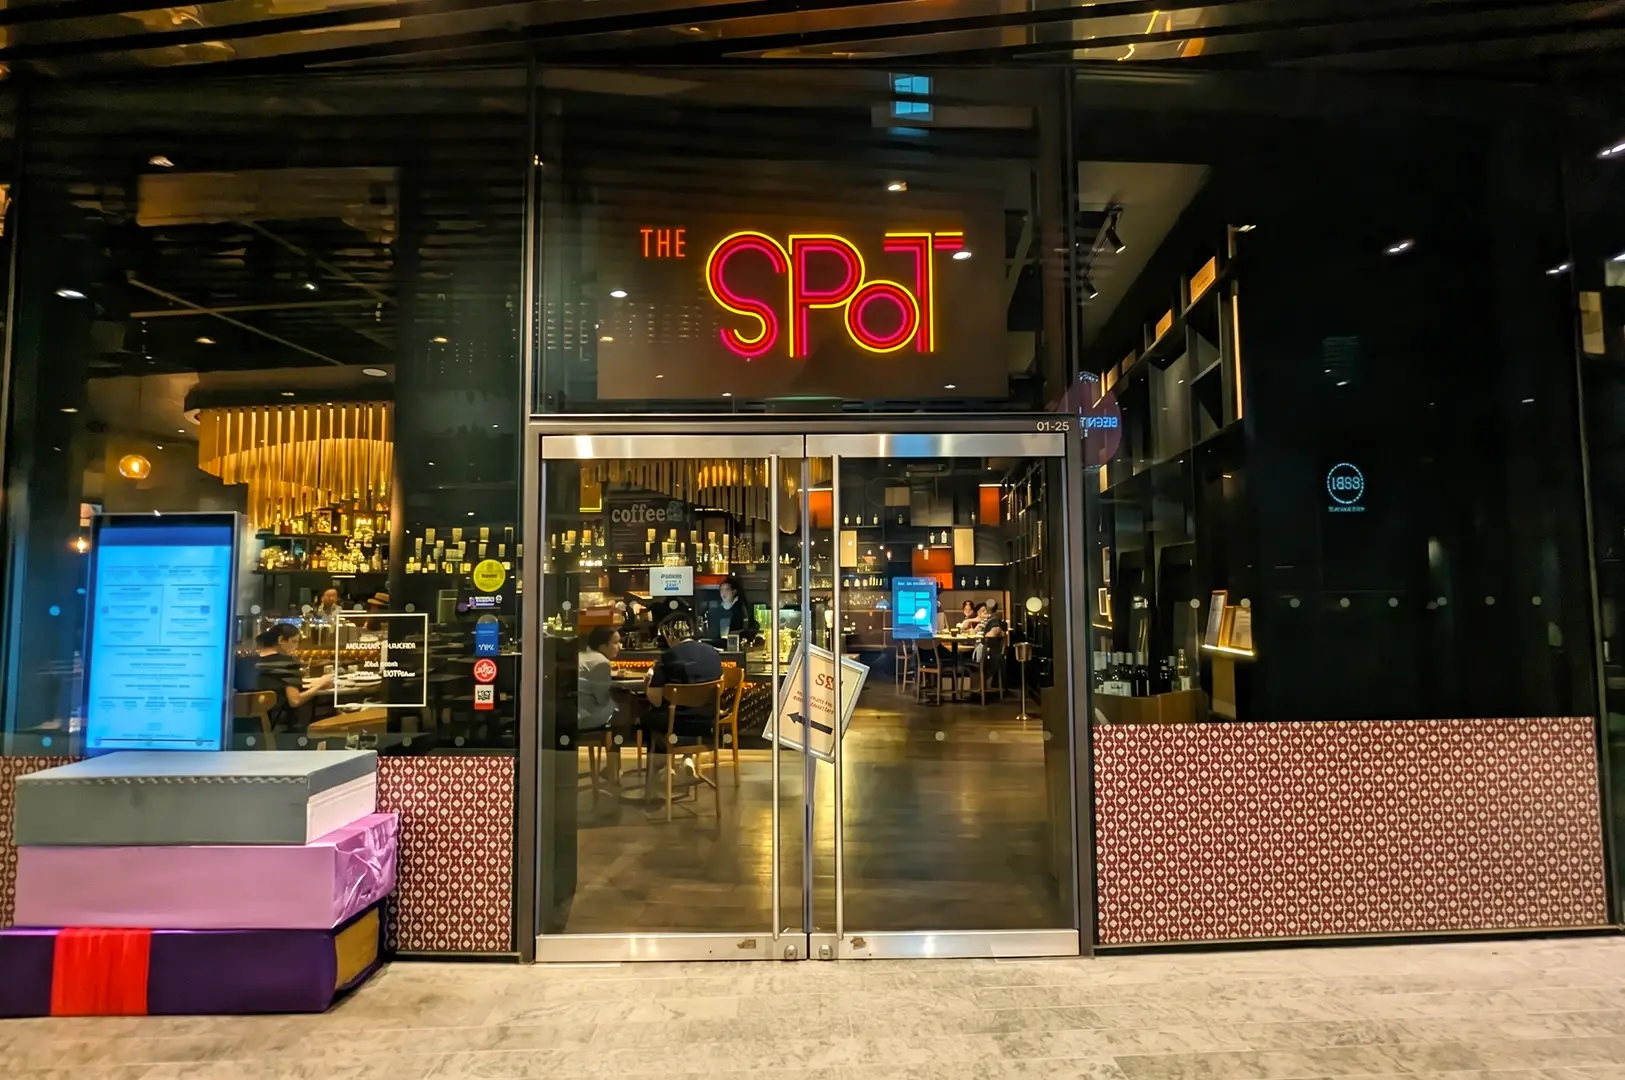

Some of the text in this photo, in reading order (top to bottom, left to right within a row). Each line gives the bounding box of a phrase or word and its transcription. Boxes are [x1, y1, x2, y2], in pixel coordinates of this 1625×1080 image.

[640, 228, 686, 258] THE
[1036, 421, 1070, 432] 01-25
[611, 504, 666, 523] coffee
